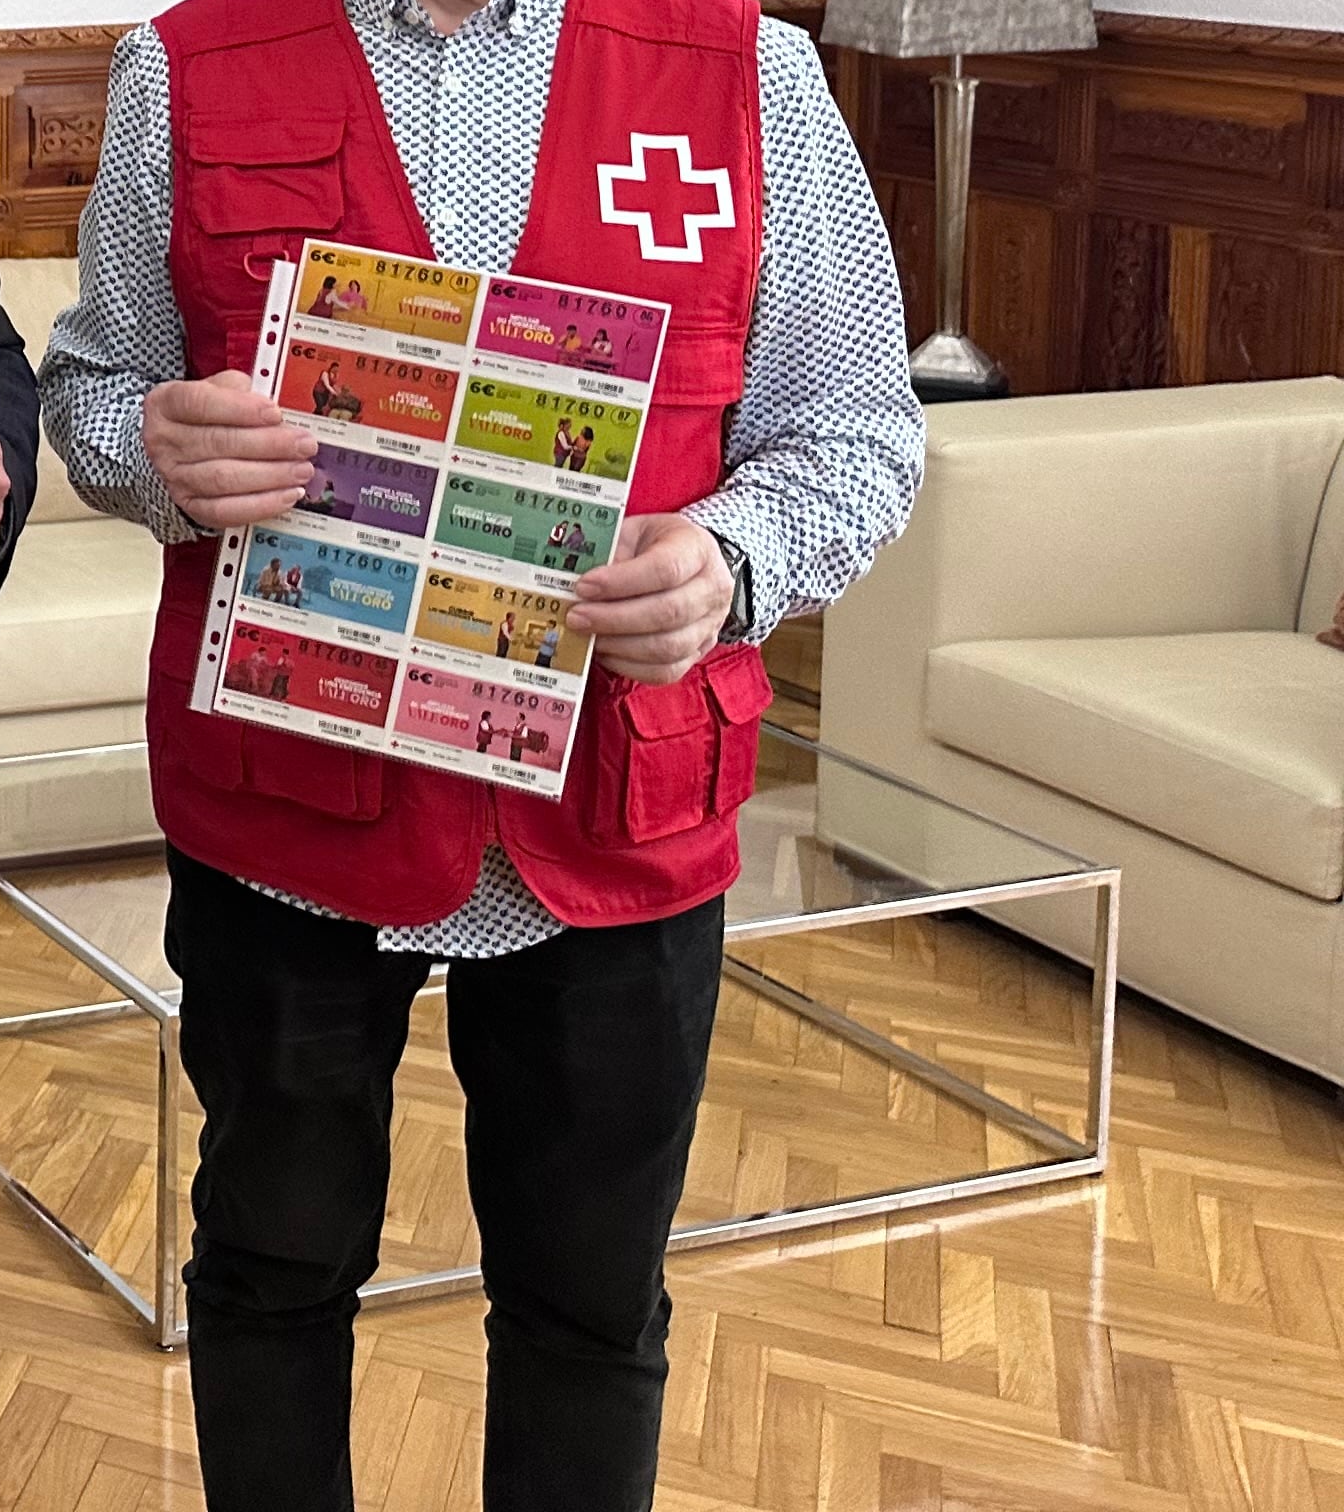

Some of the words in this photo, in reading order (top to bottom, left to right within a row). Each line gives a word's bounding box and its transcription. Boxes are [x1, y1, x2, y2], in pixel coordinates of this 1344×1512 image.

[310, 250, 335, 264] 6€
[376, 261, 443, 284] 81760
[491, 284, 517, 299] 6€
[559, 295, 627, 319] 81760
[292, 345, 316, 359] 6€
[470, 382, 495, 396] 6€
[536, 394, 605, 418] 81760
[449, 478, 474, 493] 6€
[318, 545, 383, 571] 81760
[429, 575, 453, 589] 6€
[494, 588, 560, 612] 81760
[409, 670, 433, 684] 6€
[473, 683, 539, 708] 81760
